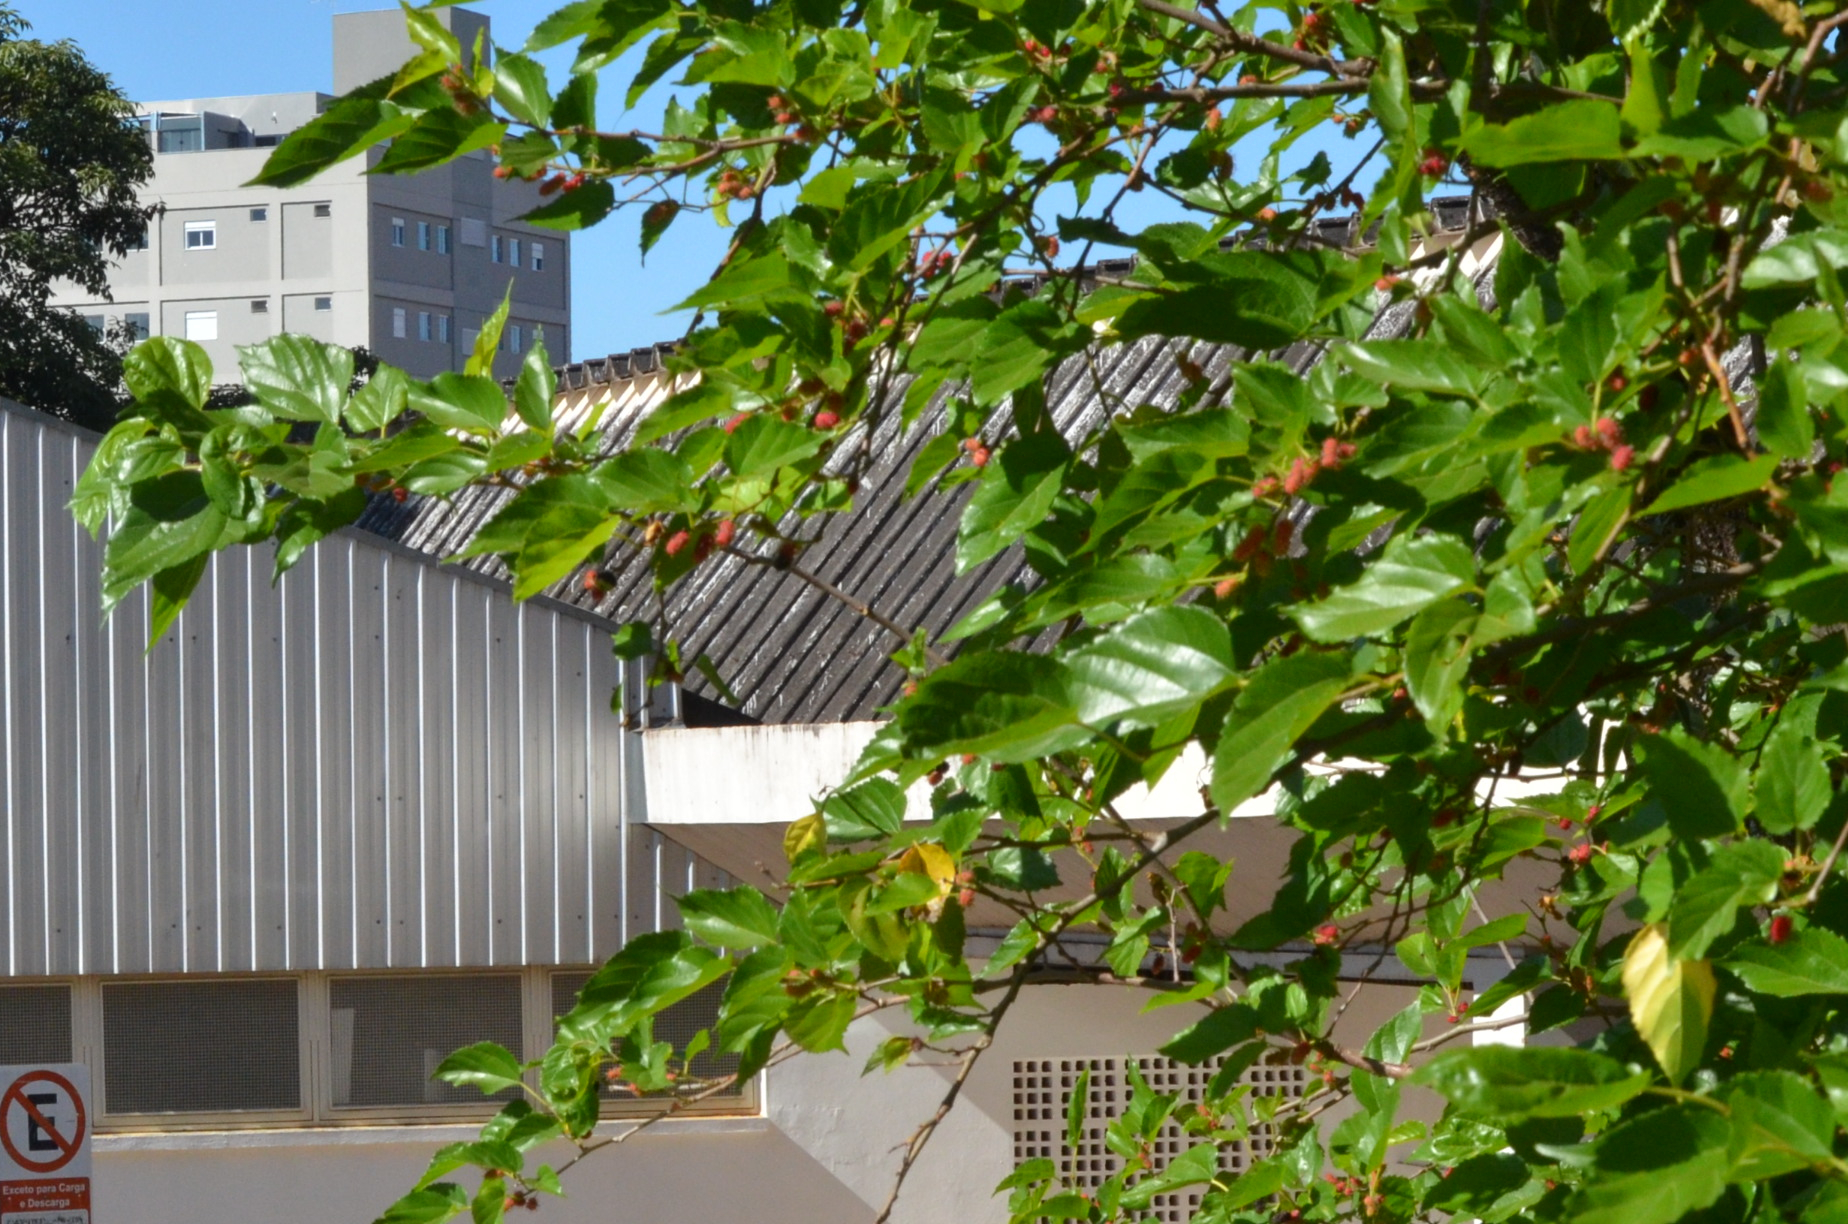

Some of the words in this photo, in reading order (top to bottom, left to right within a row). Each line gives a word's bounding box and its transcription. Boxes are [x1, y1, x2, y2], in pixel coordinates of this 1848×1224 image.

[3, 1185, 34, 1195] Exceto
[36, 1185, 56, 1195] para
[59, 1183, 85, 1193] Carga
[28, 1199, 70, 1208] Descarga
